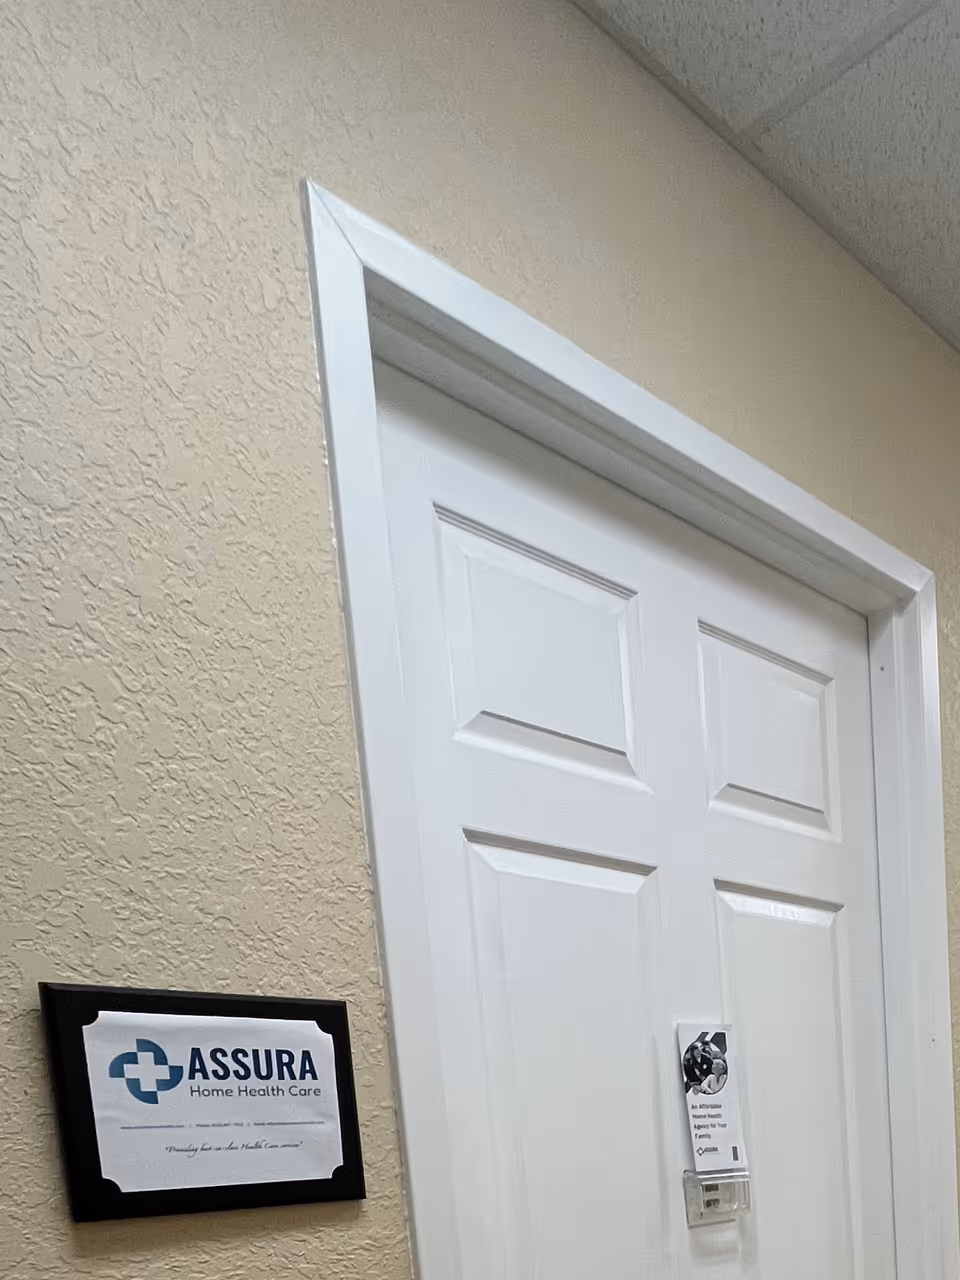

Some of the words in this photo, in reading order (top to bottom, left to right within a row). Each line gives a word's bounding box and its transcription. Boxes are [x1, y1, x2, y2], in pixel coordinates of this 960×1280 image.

[188, 1047, 319, 1081] ASSURA
[190, 1085, 233, 1097] Home
[238, 1085, 284, 1097] Health
[288, 1085, 321, 1097] Care
